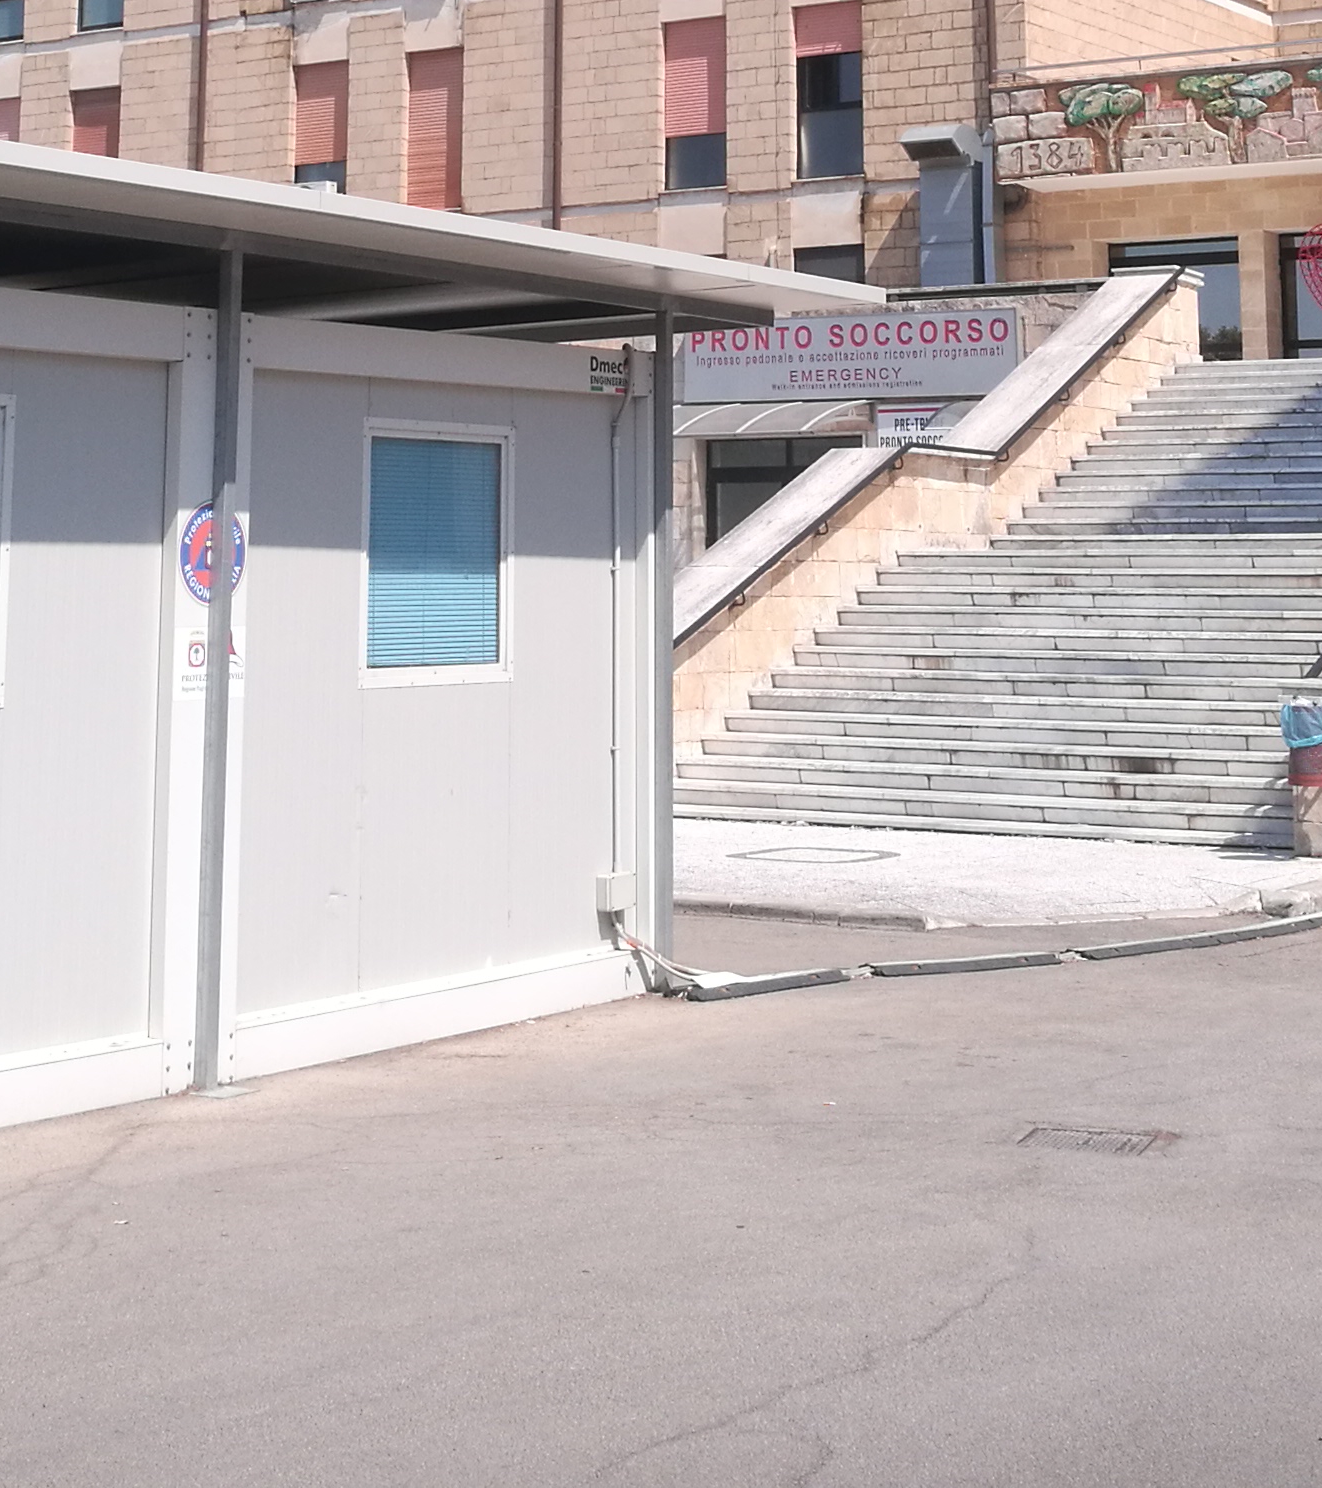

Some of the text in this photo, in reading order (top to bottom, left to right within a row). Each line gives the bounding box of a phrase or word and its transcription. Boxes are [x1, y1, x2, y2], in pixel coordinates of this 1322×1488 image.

[1010, 141, 1084, 173] 1384
[690, 316, 1009, 353] PRONTO SOCCORSO
[696, 355, 741, 369] Ingresso
[745, 352, 793, 367] pedonale
[809, 349, 879, 362] accettazione
[884, 347, 927, 361] ricoveri
[932, 344, 1004, 360] programmati
[789, 367, 902, 383] EMERGENCY
